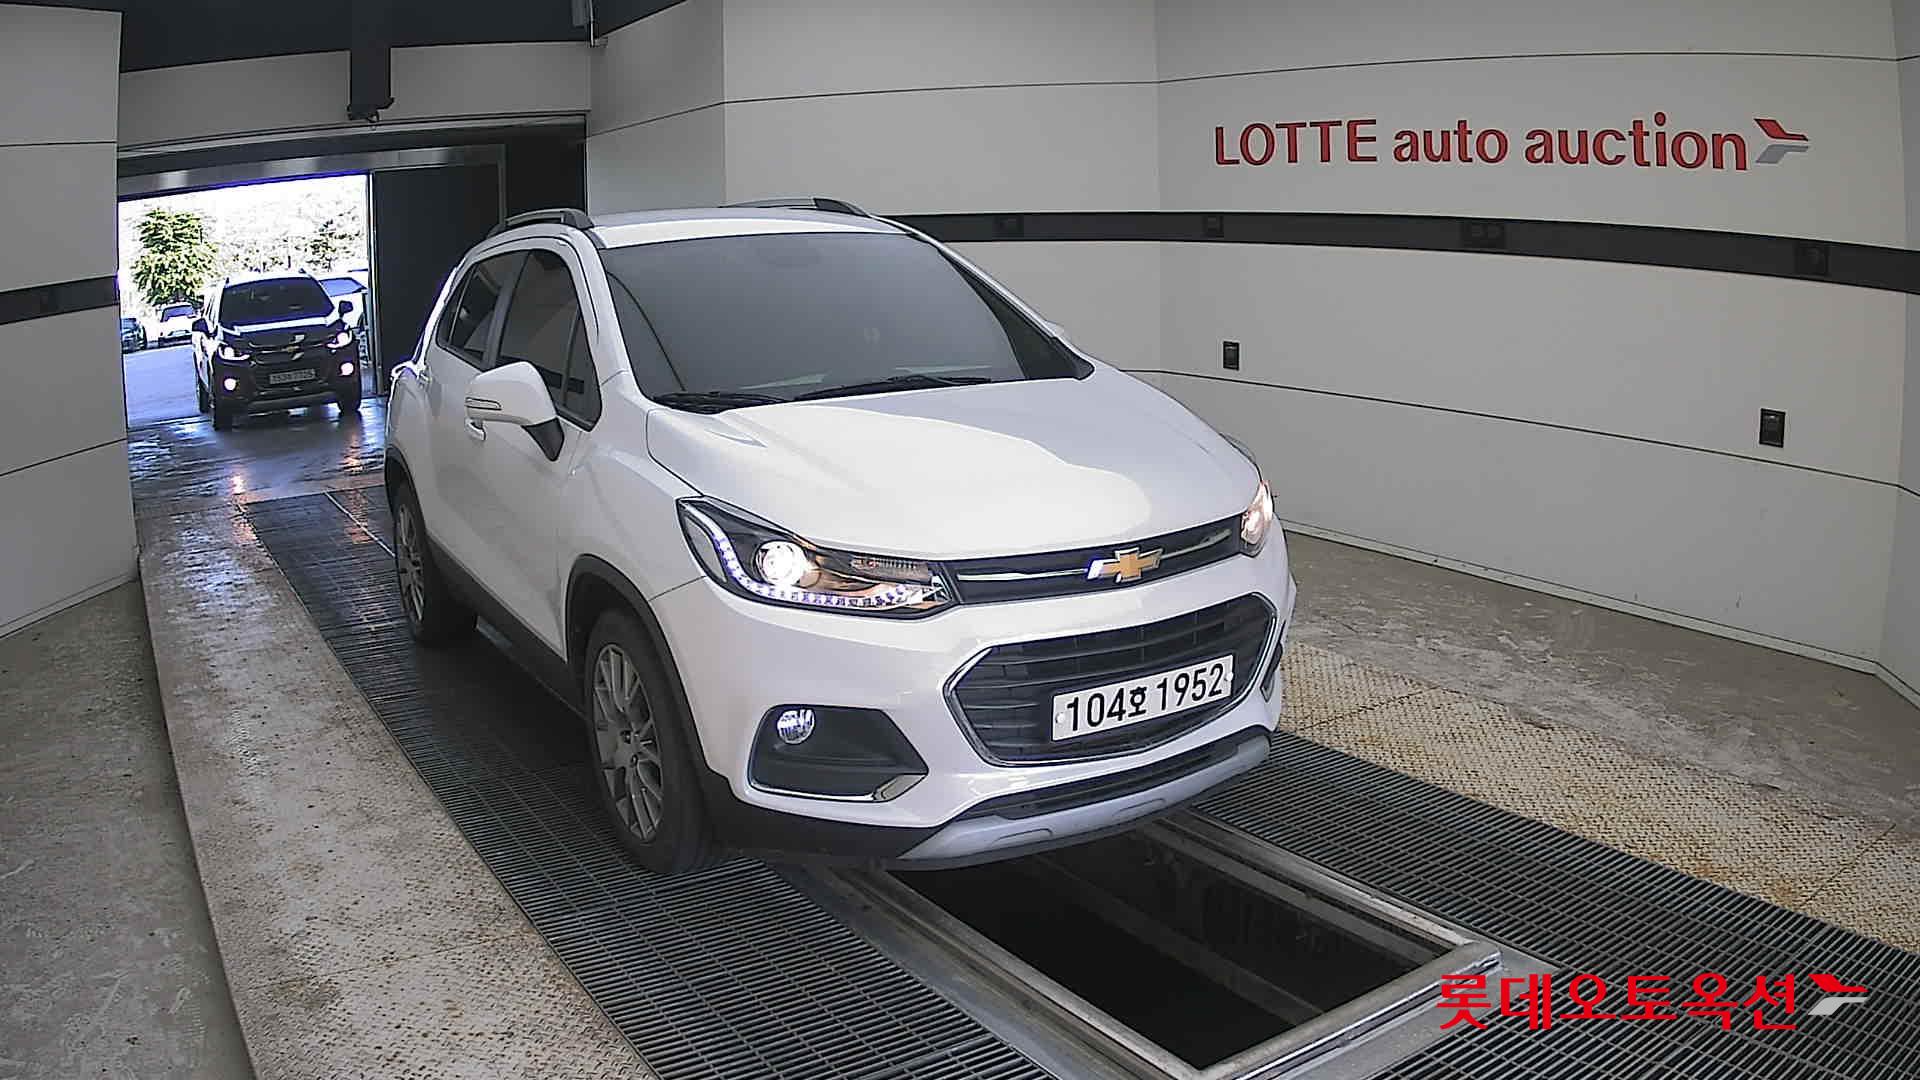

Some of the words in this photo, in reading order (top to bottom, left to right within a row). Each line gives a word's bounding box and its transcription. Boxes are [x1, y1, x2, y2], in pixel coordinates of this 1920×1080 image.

[1215, 119, 1377, 166] LOTTE
[1393, 120, 1508, 163] auto
[1524, 111, 1748, 171] auction
[1067, 686, 1148, 731] 104호
[1156, 663, 1224, 711] 1952
